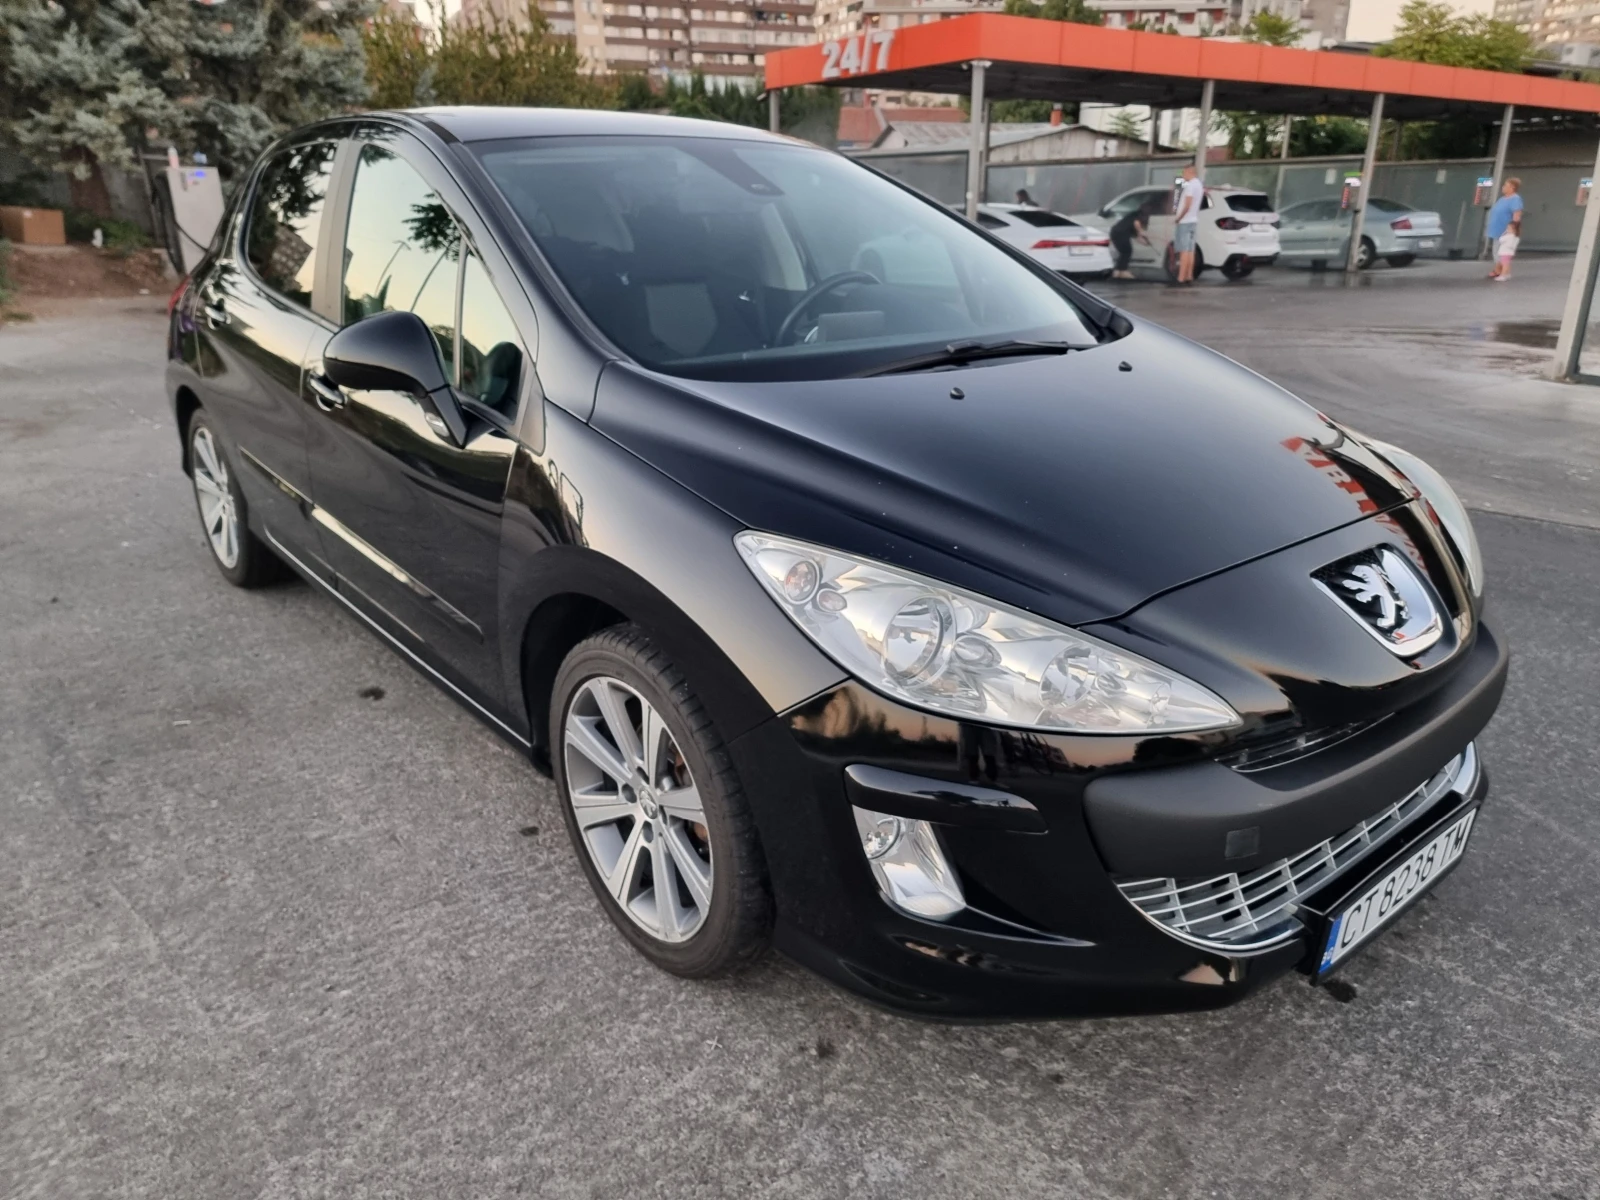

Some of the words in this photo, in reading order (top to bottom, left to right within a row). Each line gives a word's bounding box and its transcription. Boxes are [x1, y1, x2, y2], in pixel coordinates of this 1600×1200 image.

[822, 25, 895, 79] 24/7
[1341, 888, 1379, 949] CT
[1379, 842, 1437, 917] 8238
[1440, 815, 1471, 867] TM
